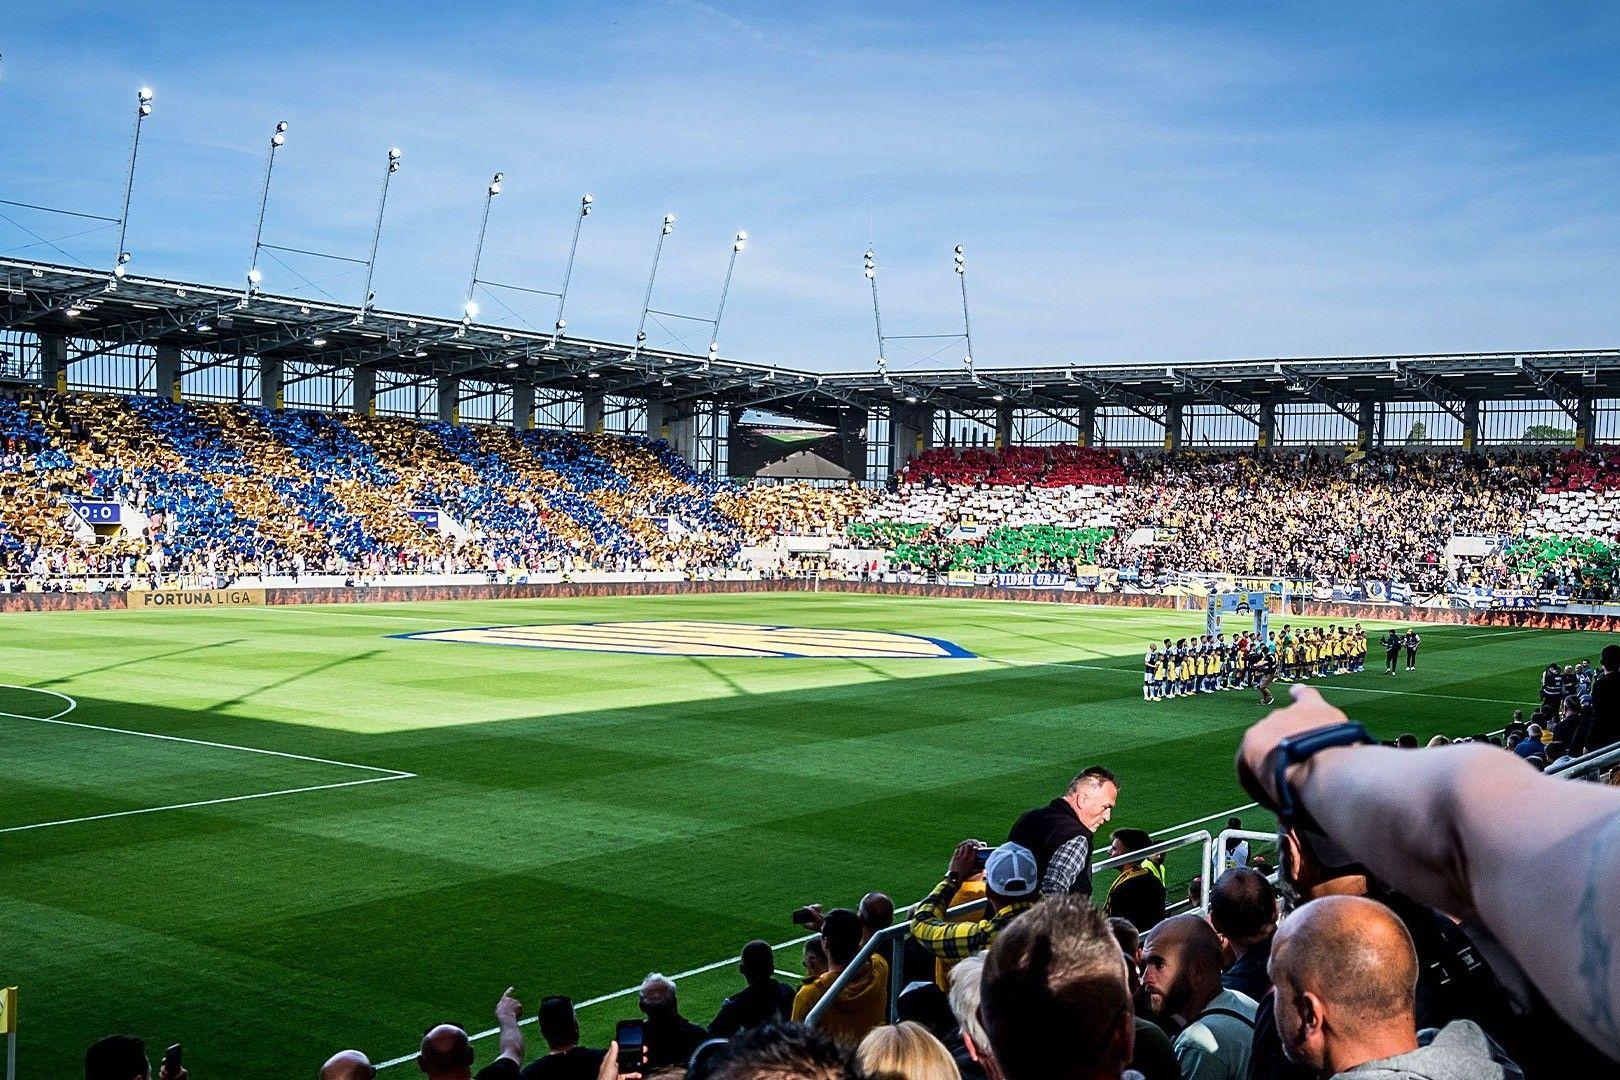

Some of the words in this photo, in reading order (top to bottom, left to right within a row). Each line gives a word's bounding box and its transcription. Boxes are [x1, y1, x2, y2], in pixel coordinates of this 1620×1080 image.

[80, 505, 112, 519] 0:0
[144, 593, 213, 605] FORTUNA
[217, 592, 251, 604] LIGA
